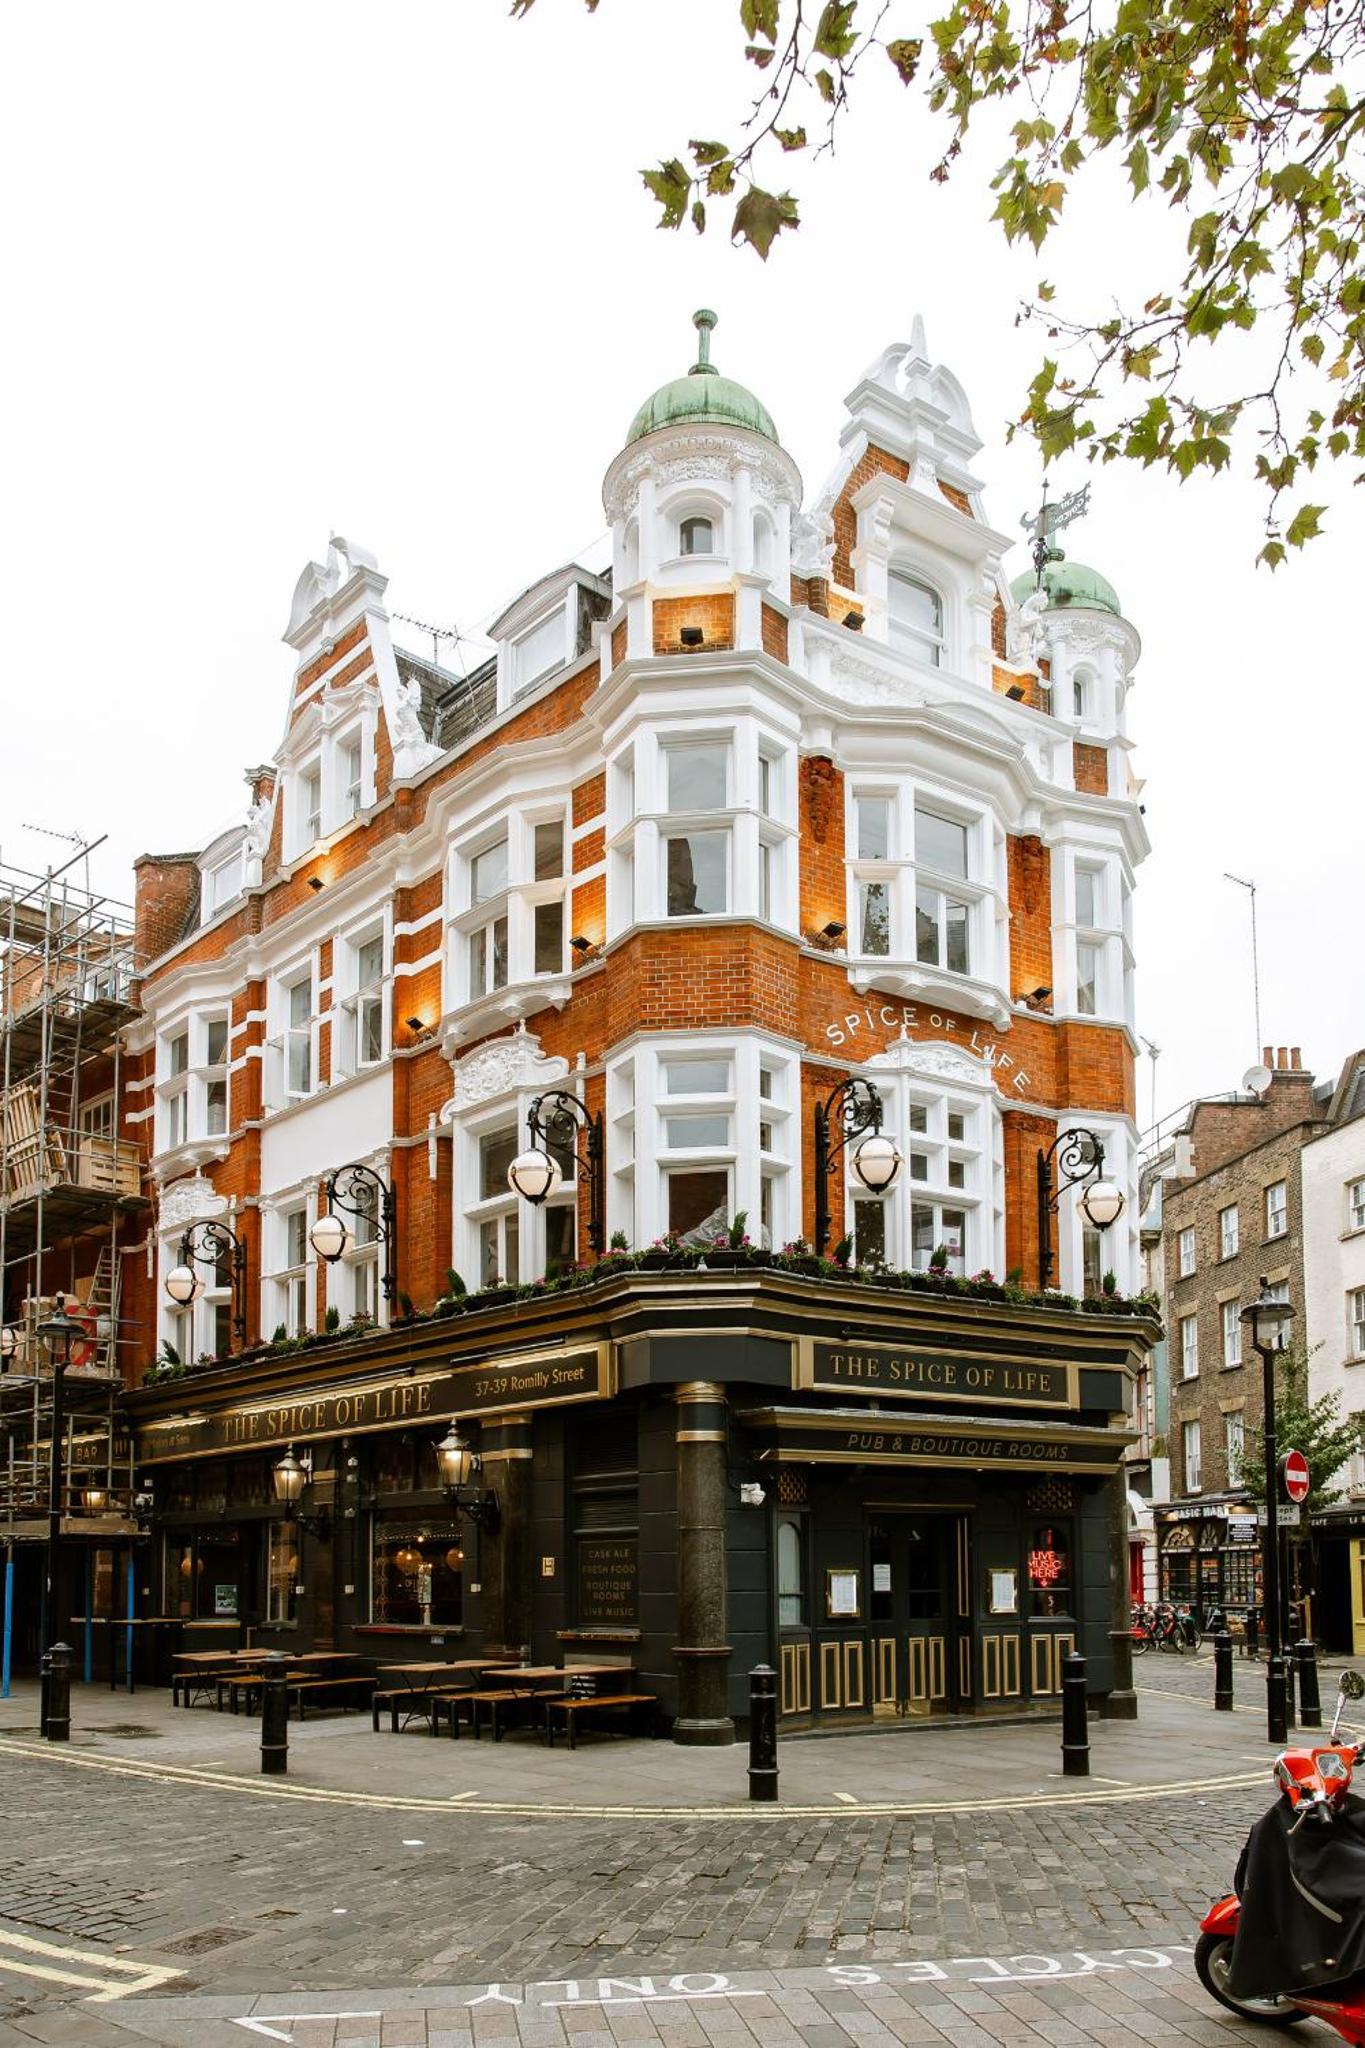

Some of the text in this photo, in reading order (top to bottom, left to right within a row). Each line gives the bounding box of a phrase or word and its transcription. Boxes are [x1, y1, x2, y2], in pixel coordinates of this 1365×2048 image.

[826, 1006, 918, 1045] SPICE
[930, 1014, 956, 1031] OF
[830, 1355, 1051, 1392] THE SPICE OF LIFE
[475, 1367, 584, 1397] 37-39 Romilly Street
[223, 1384, 431, 1442] THE SPICE OF LIFE
[848, 1434, 1069, 1459] PUB & BOUTIQUE ROOMS
[588, 1548, 630, 1559] CASK ALE
[1031, 1551, 1056, 1560] LIVE
[582, 1563, 636, 1574] FRESH FOOD
[1028, 1560, 1062, 1570] MUSIC
[1029, 1568, 1059, 1579] HERE
[586, 1580, 632, 1591] BOUTIQUE
[593, 1591, 625, 1601] ROOMS
[584, 1607, 635, 1617] LIVE MUSIC
[463, 1972, 738, 2006] ONLY
